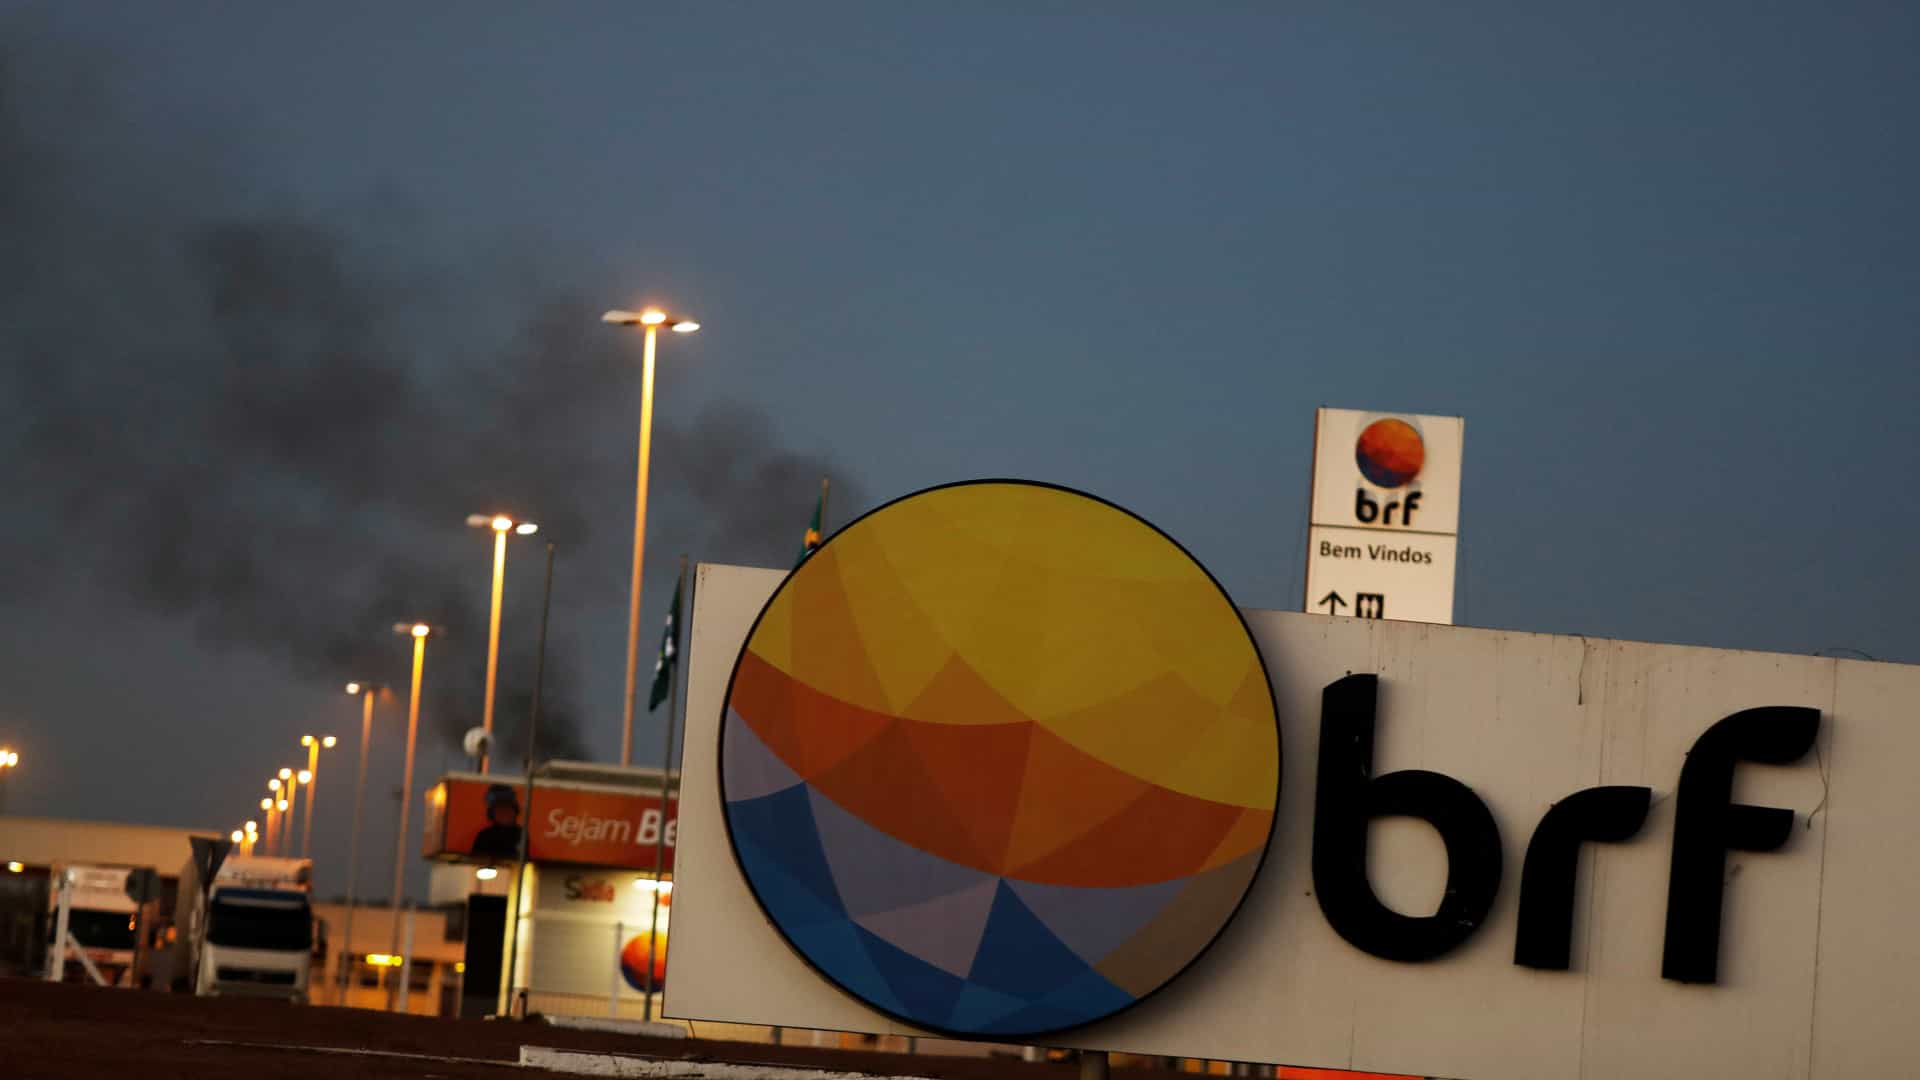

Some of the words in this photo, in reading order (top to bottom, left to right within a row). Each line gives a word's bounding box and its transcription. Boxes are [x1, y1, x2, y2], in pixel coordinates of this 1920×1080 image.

[1355, 488, 1422, 525] brf
[1320, 541, 1361, 559] Bem
[1367, 544, 1432, 564] Vindos
[544, 808, 630, 846] Sejam
[1312, 673, 1821, 984] brf
